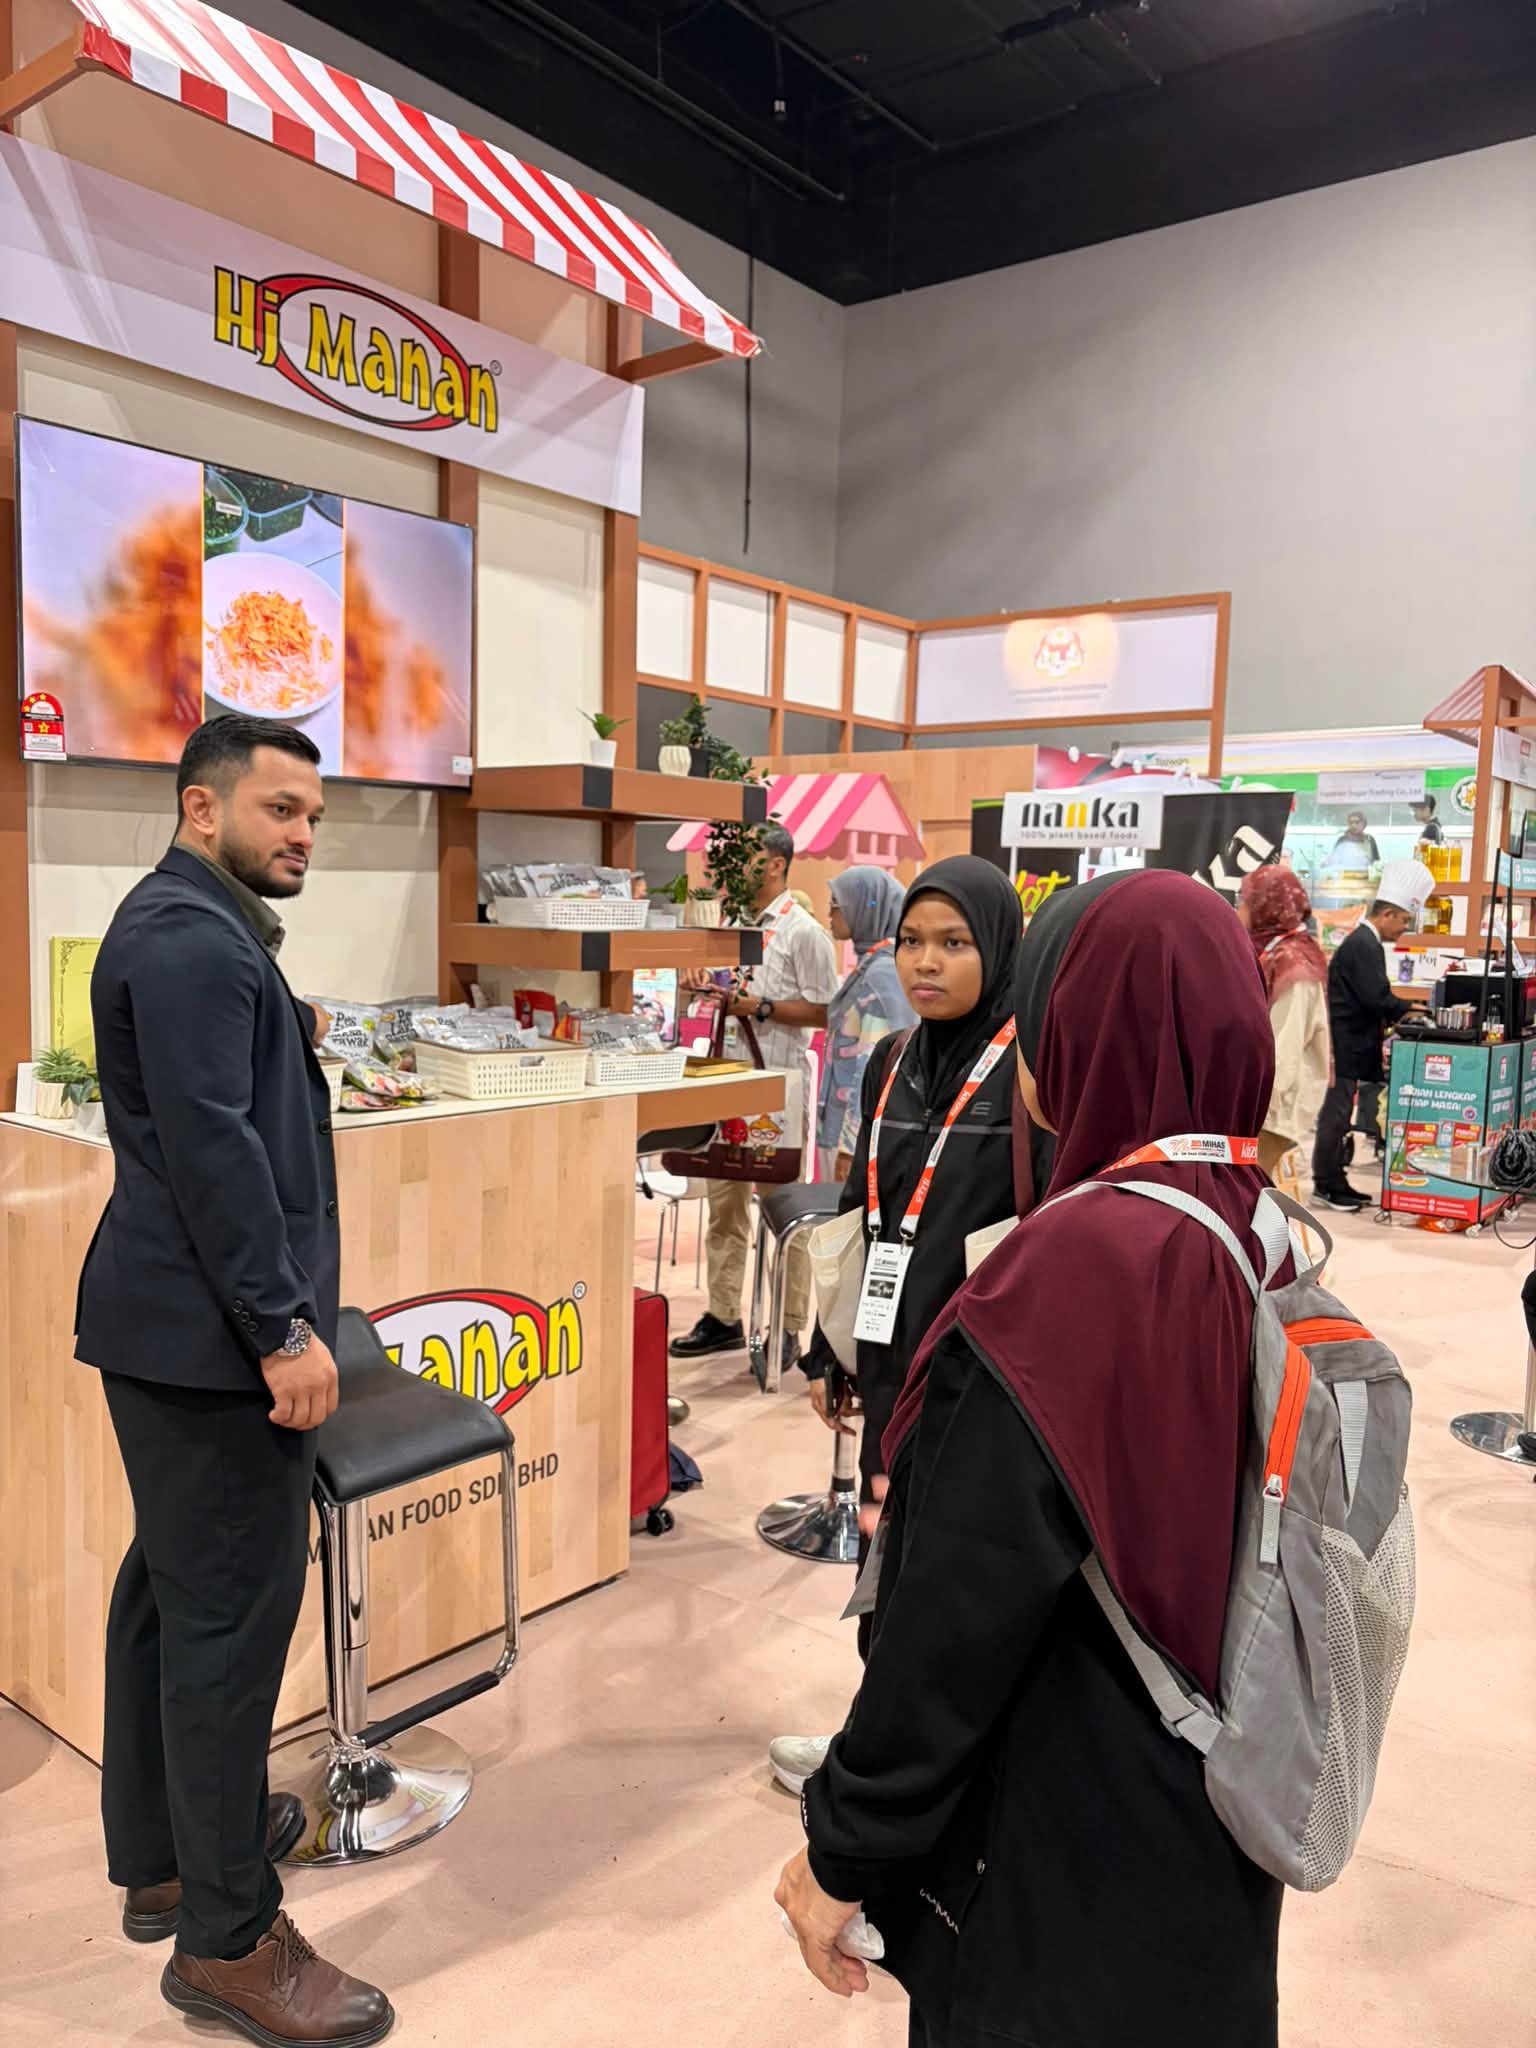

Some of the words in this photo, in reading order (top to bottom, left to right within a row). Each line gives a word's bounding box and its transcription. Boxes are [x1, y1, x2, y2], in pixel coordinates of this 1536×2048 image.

[213, 265, 281, 366] Hj
[304, 302, 499, 433] Manan
[1020, 797, 1140, 829] nanka
[1021, 830, 1046, 840] 100%
[1048, 831, 1074, 841] plant
[1077, 830, 1106, 840] based
[1110, 830, 1138, 840] foods
[1202, 1139, 1226, 1149] MIHAS
[384, 1296, 583, 1401] anan
[402, 1488, 462, 1531] FOOD
[518, 1453, 559, 1488] BHD
